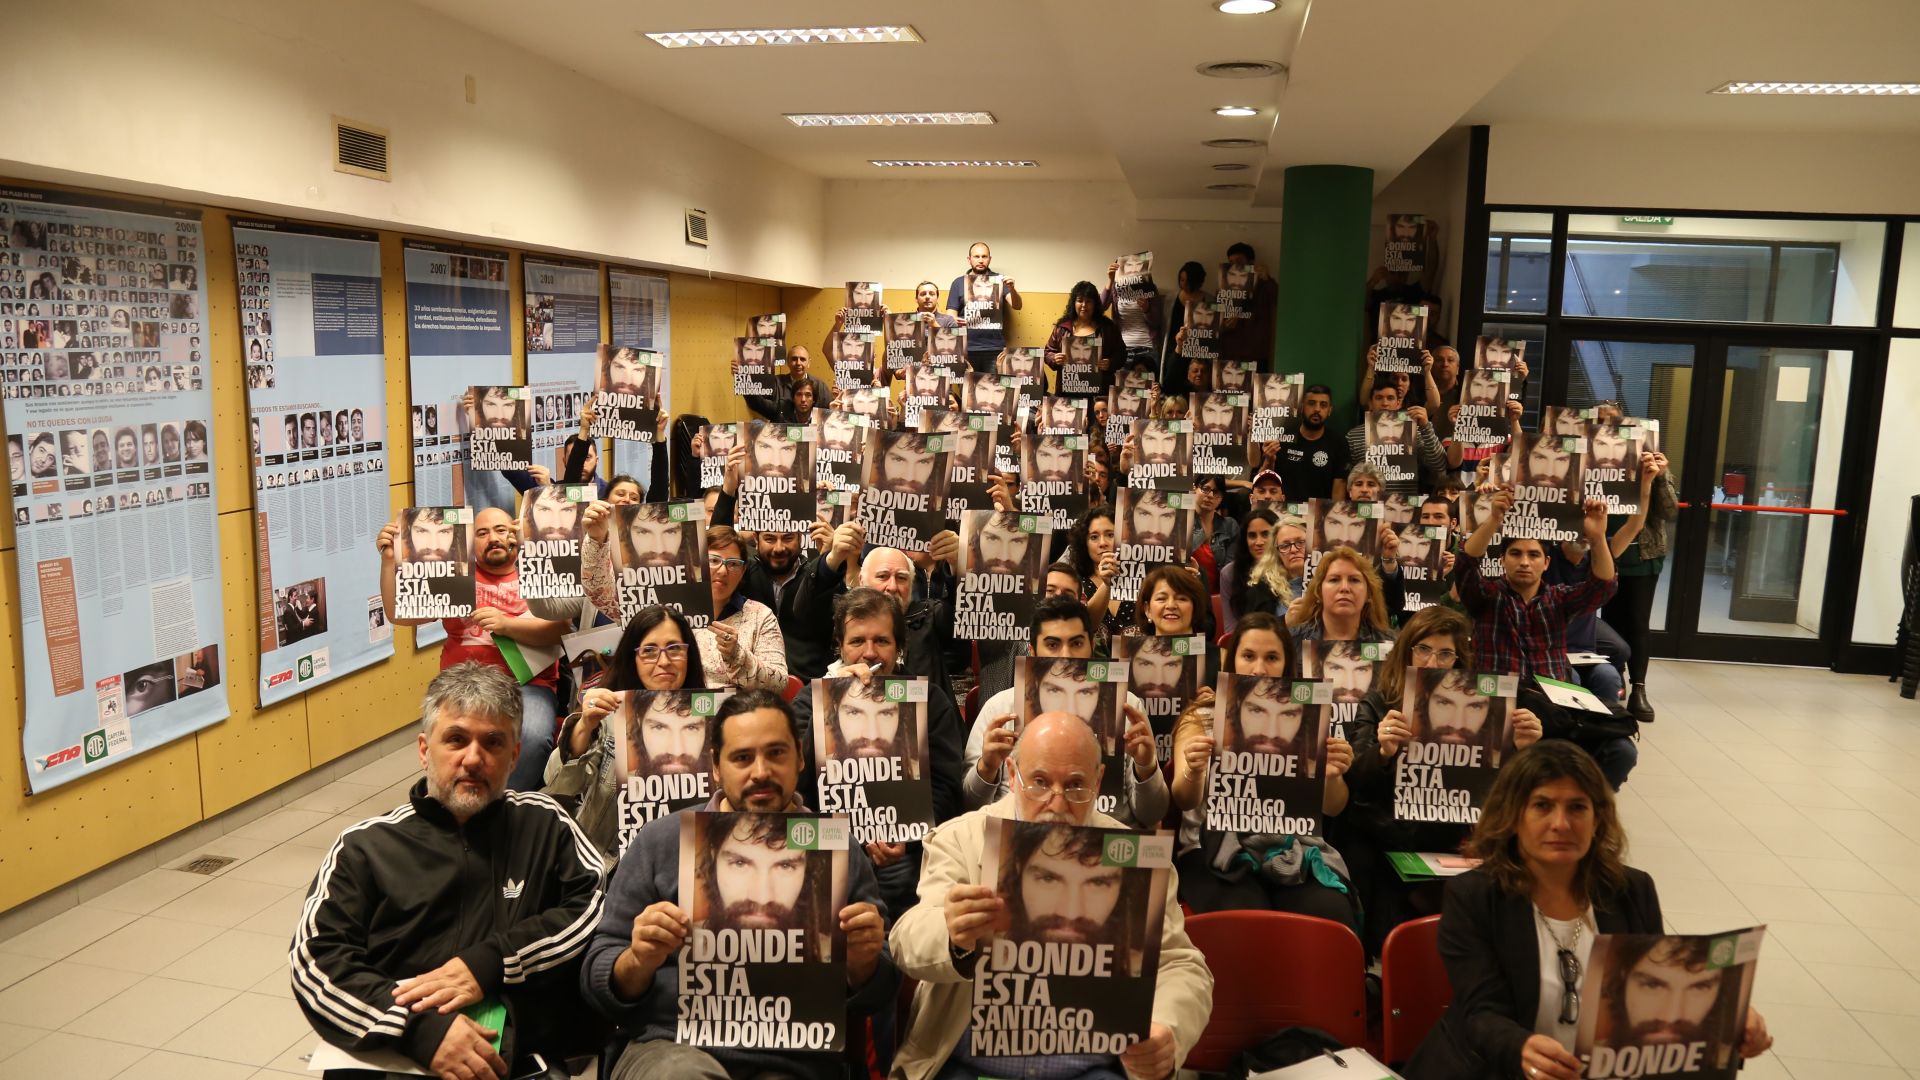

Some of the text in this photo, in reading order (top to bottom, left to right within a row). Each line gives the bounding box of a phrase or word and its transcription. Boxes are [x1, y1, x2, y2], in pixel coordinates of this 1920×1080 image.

[175, 222, 197, 233] 2006
[430, 263, 447, 275] 2007
[886, 340, 915, 350] ¿DONDE
[1376, 337, 1414, 349] ¿DONDE
[1062, 364, 1092, 373] ¿DONDE
[1374, 363, 1422, 374] MALDONADO?
[1375, 356, 1409, 365] SANTIAGO
[737, 366, 764, 374] DONDE
[1253, 407, 1289, 419] ¿DONDE
[37, 420, 46, 428] TE
[47, 418, 76, 428] QUEDES
[1252, 427, 1285, 435] SANTIAGO
[1454, 426, 1491, 435] SANTIAGO
[470, 428, 516, 441] ¿DONDE
[588, 426, 652, 442] MALDONADO?
[1193, 433, 1232, 445] DONDE
[1453, 434, 1505, 445] MALDONADO?
[470, 439, 497, 452] ESTÁ
[1365, 444, 1404, 456] ¿DONDE
[471, 452, 513, 461] SANTIAGO
[700, 456, 724, 468] ¿DON
[816, 448, 852, 463] DONDE
[1193, 456, 1228, 466] ANTIAGO
[470, 461, 529, 471] MALDONADO?
[1128, 463, 1176, 479] ¿DONDE
[1584, 469, 1625, 482] DONDE
[738, 477, 796, 494] ¿DONDE
[1021, 481, 1072, 497] ¿DONDE
[738, 492, 772, 508] ESTÁ
[856, 488, 929, 513] ¿DONDE
[1513, 485, 1567, 504] DONDE
[738, 507, 791, 521] SANTIAGO
[737, 519, 813, 534] MALDONADO?
[1502, 515, 1558, 530] SANTIAGO
[1500, 526, 1578, 544] MALDONADO?
[517, 540, 579, 560] ¿DONDE
[395, 561, 455, 581] ¿DONDE
[518, 556, 555, 574] ESTÁ
[519, 572, 575, 587] SANTIAGO
[615, 565, 687, 589] ¿DONDE
[956, 574, 1025, 594] ¿DONDE
[396, 577, 430, 595] ESTÁ
[519, 585, 584, 600] MALDONAD
[396, 593, 450, 607] SANTIAGO
[617, 584, 659, 605] ESTÁ
[955, 592, 995, 612] ESTÁ
[395, 605, 472, 620] MALDONADO?
[954, 611, 1016, 626] SANTIAGO
[951, 625, 1030, 641] MALDONADO
[108, 730, 124, 740] CAPITAL
[108, 737, 128, 747] FEDERAL
[1397, 742, 1483, 768] ¿DONDE
[816, 757, 903, 788] ¿DONDE
[1209, 752, 1298, 778] ¿DONDE
[1395, 764, 1445, 788] ESTÁ
[617, 773, 710, 806] ¿DONDE
[1208, 774, 1260, 798] ESTÁ
[818, 781, 868, 810] ESTÁ
[1392, 785, 1470, 807] SANTIAGO
[1206, 795, 1286, 816] SANTIAGO
[1389, 802, 1479, 825] MALDONAD
[1203, 812, 1315, 836] MALDONADO?
[678, 929, 804, 965] ¿DONDE
[974, 941, 1114, 977] ¿DONDE
[679, 960, 750, 996] ESTÁ
[973, 972, 1053, 1007] ESTÁ
[678, 995, 791, 1021] SANTIAGO
[971, 1004, 1095, 1032] SANTIAGO
[676, 1020, 835, 1049] MALDONADO?
